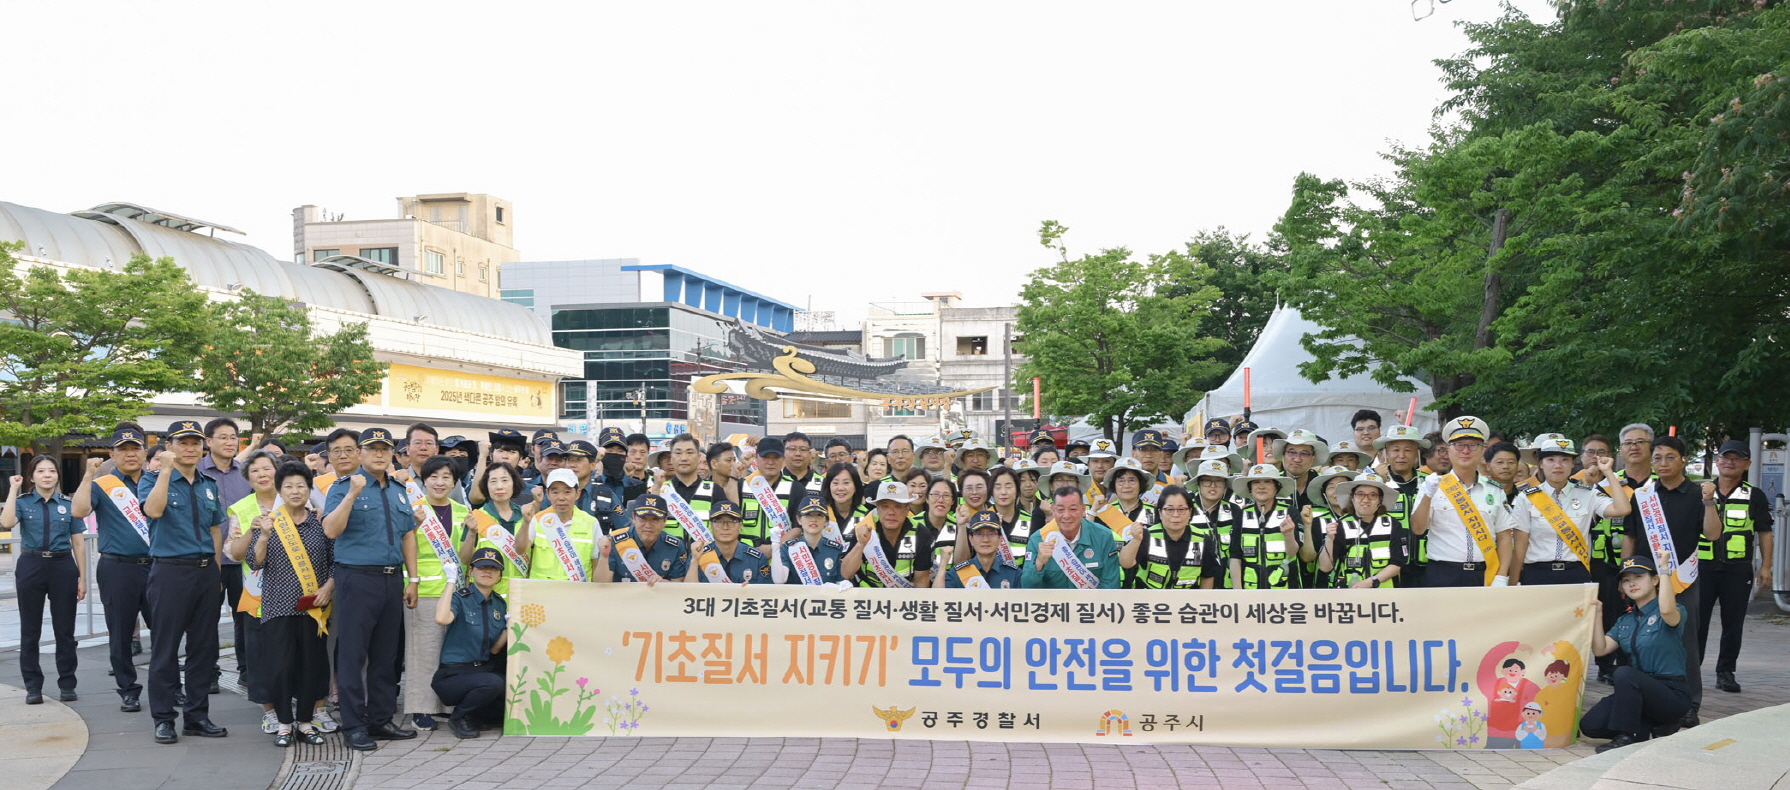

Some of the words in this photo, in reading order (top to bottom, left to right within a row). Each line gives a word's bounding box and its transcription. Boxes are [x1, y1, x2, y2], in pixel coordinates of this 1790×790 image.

[440, 389, 462, 404] 2025년
[463, 391, 481, 405] 색다른
[482, 392, 494, 406] 공주
[494, 394, 506, 407] 밤의
[668, 504, 695, 529] 기초질서
[670, 493, 681, 504] 좋은
[679, 501, 694, 518] 습관이
[1452, 490, 1474, 516] 교통질서
[1649, 494, 1664, 525] 서민경제
[1657, 524, 1669, 541] 질서
[428, 516, 451, 549] 서민경제
[556, 526, 568, 541] 좋은
[564, 540, 577, 560] 습관이
[552, 539, 575, 572] 기초질서
[799, 545, 819, 579] 서민경제
[870, 557, 892, 584] 기초질서
[1059, 559, 1087, 589] 기초질서
[683, 597, 715, 617] 3대
[721, 597, 848, 620] 기초질서(교통
[853, 600, 938, 623] 질서·생활
[943, 602, 1070, 624] 질서·서민경제
[1076, 602, 1125, 625] 질서)
[1131, 602, 1173, 624] 좋은
[1178, 602, 1239, 624] 습관이
[1245, 602, 1309, 625] 세상을
[1314, 601, 1404, 625] 바꿉니다.
[622, 630, 769, 685] '기초질서
[782, 634, 899, 687] 지키기'
[908, 636, 1011, 690] 모두의
[1025, 637, 1134, 692] 안전을
[1144, 638, 1221, 693] 위한
[1232, 638, 1469, 694] 첫걸음입니다.
